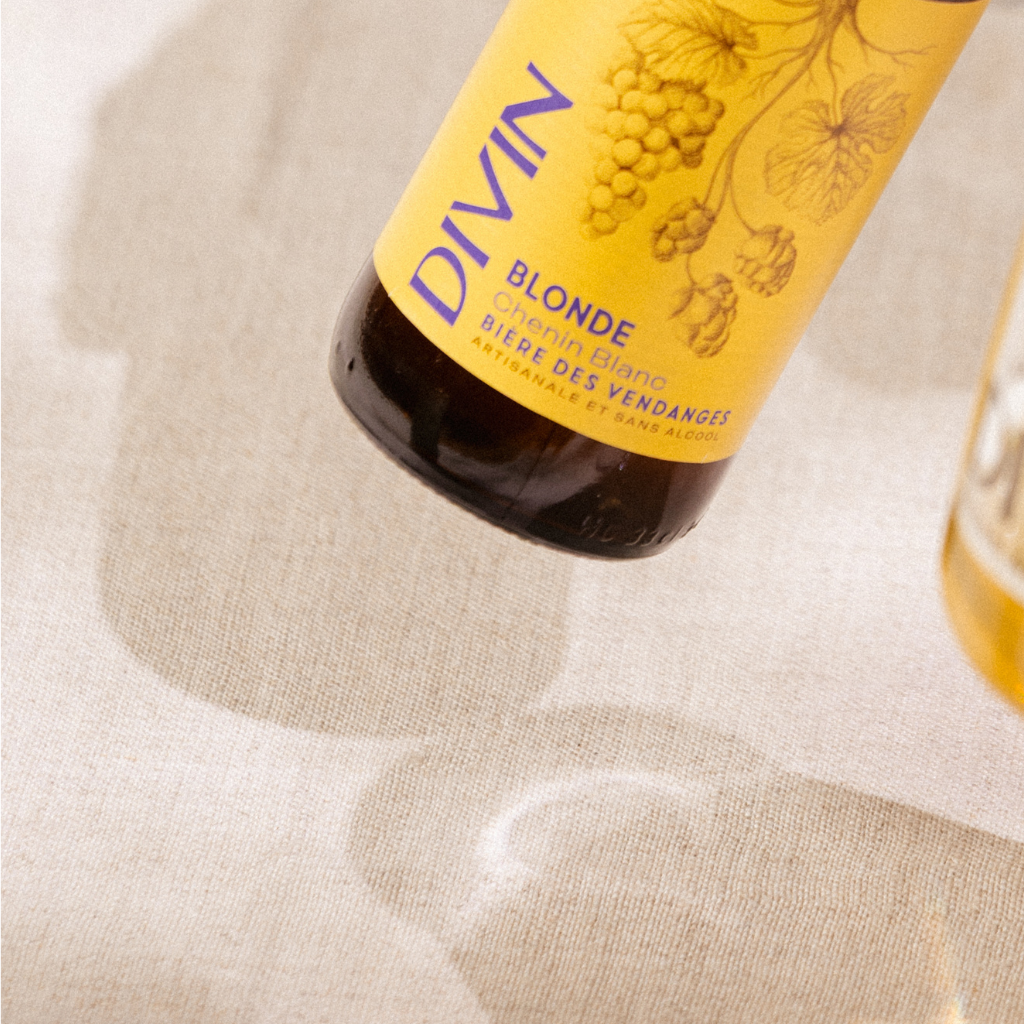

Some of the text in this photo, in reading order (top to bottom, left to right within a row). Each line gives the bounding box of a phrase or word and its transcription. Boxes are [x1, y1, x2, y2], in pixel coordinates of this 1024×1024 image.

[410, 62, 573, 326] DIVIN
[493, 291, 667, 391] Chenin Blanc
[506, 259, 636, 347] BLONDE
[471, 336, 719, 441] ARTISANALE ET SANS ALCOOL
[481, 314, 732, 426] BIÈRE DES VENDANGES
